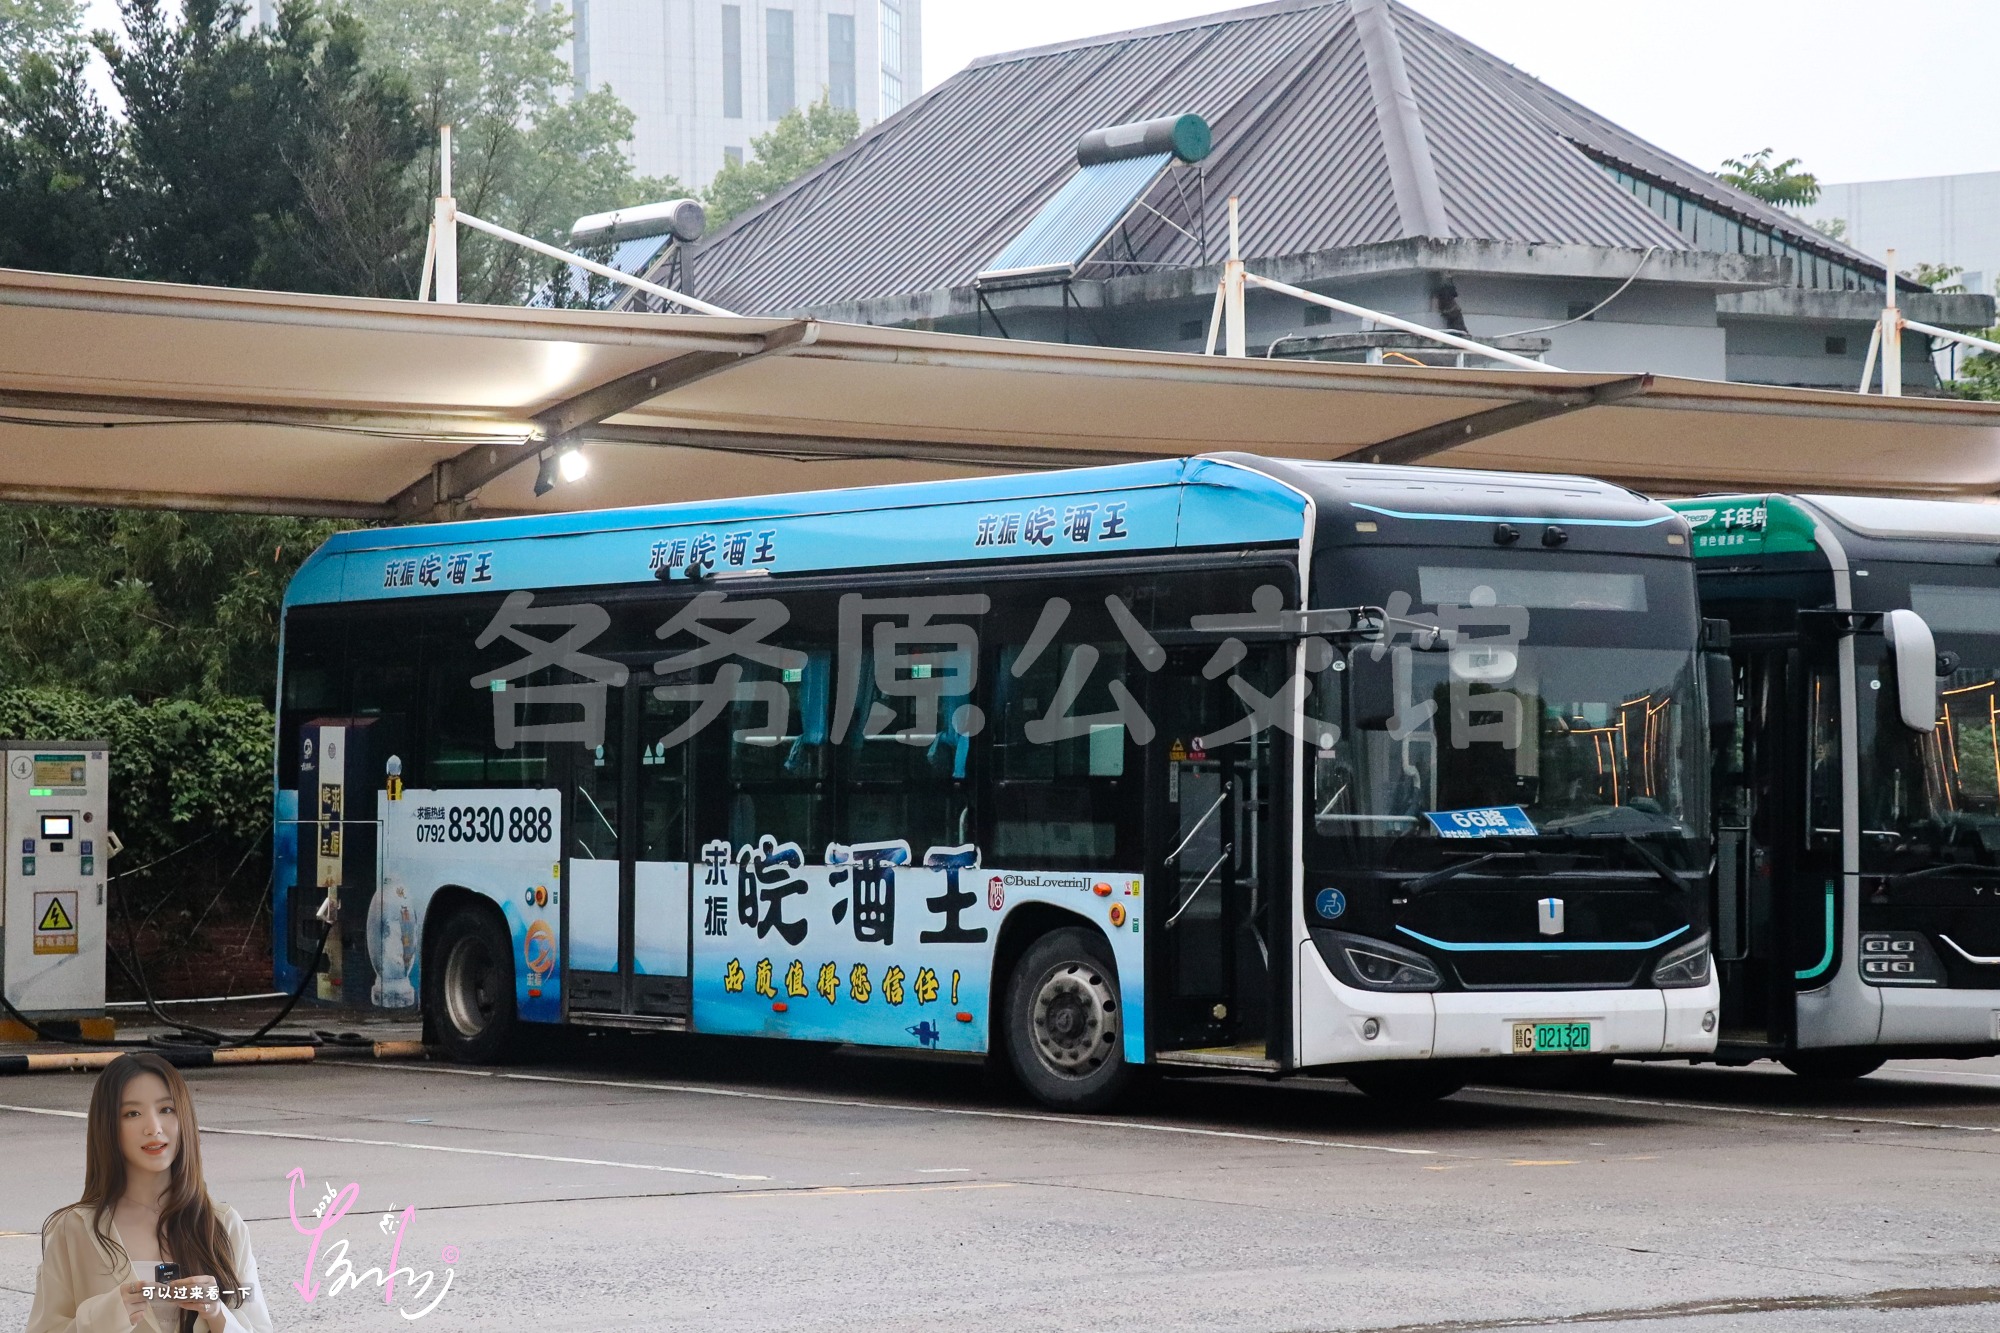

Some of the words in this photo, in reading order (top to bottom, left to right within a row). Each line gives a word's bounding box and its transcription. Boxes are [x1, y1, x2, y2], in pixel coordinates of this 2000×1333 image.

[974, 502, 1128, 547] 求振皖酒王
[383, 551, 493, 588] 求振皖酒王
[649, 531, 777, 570] 求振皖酒王
[416, 824, 446, 843] 0792
[448, 806, 504, 843] 8330
[508, 806, 552, 844] 888
[1451, 810, 1509, 828] 66路
[704, 845, 728, 937] 求振
[737, 840, 989, 946] 皖酒王
